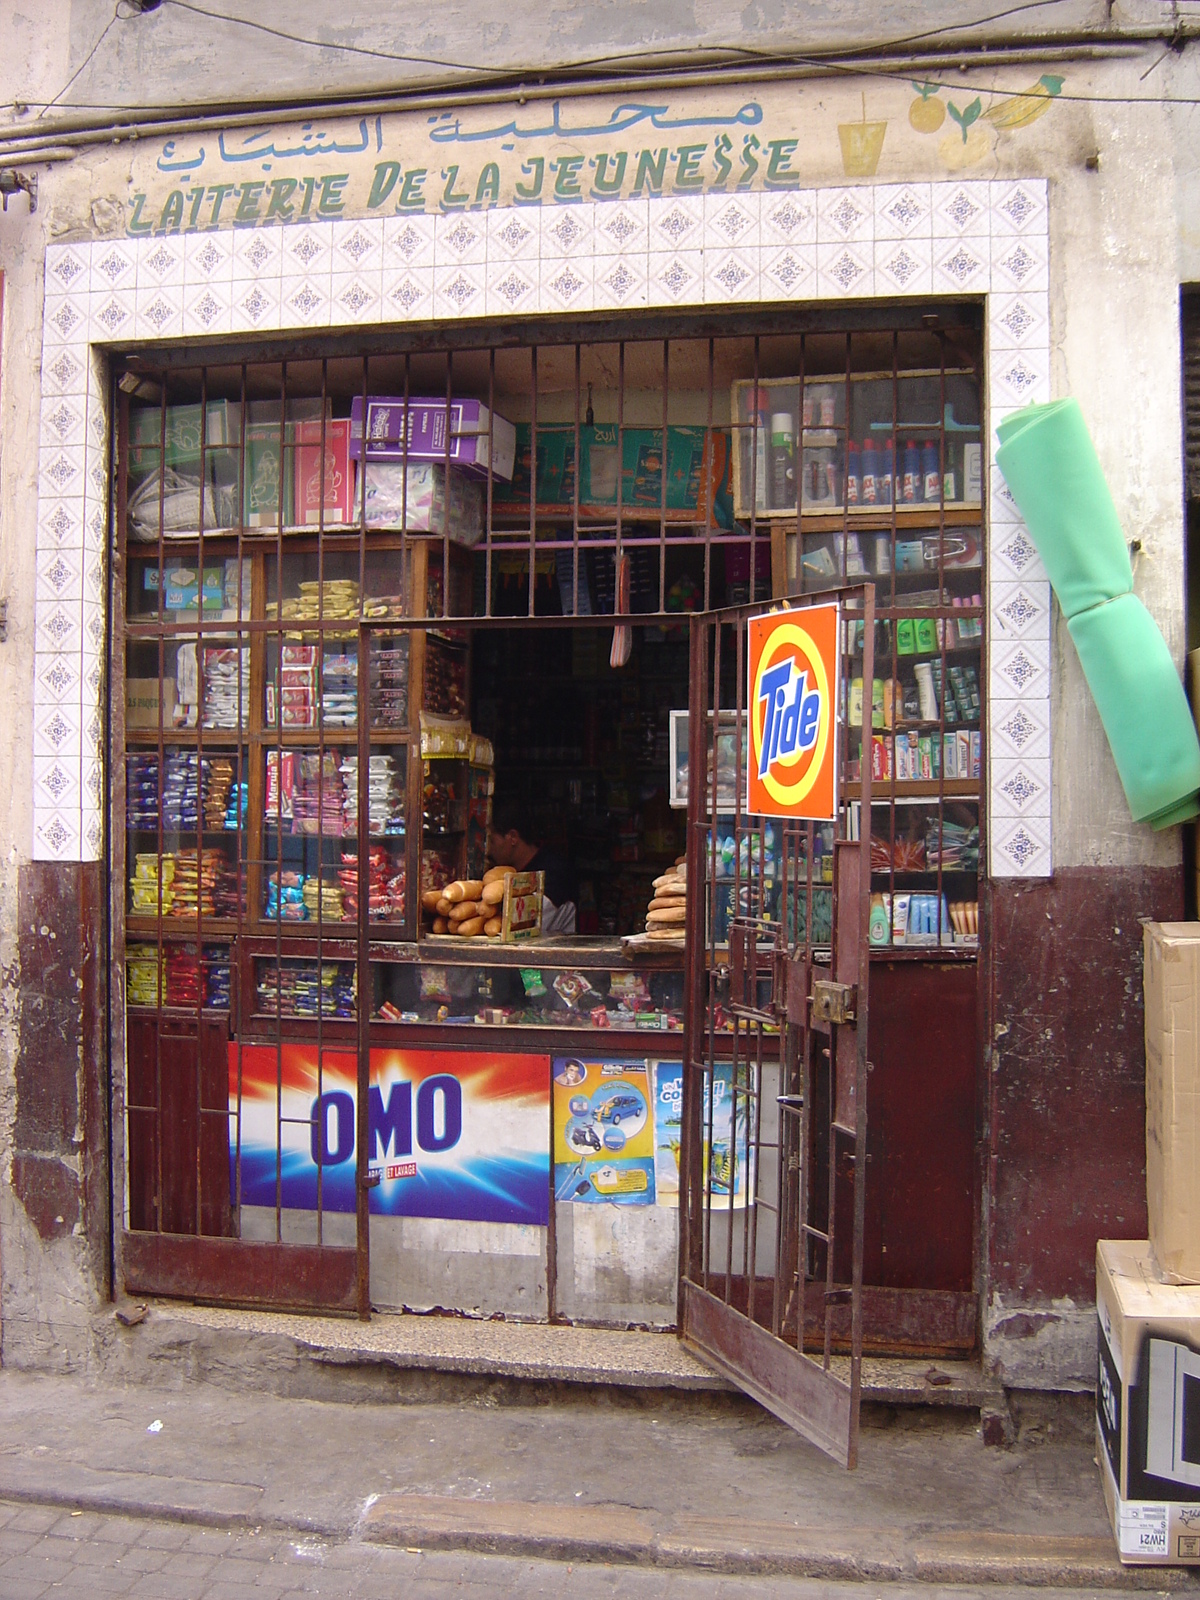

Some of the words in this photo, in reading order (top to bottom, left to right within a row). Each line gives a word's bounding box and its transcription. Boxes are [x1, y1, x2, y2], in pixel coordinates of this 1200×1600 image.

[127, 173, 350, 238] LAITERIE
[366, 161, 428, 215] DE
[440, 162, 500, 212] LA
[513, 134, 801, 207] JEUNESSE
[137, 698, 166, 709] PAQUES
[758, 657, 820, 780] Tide
[268, 766, 278, 803] Maruja
[310, 1072, 462, 1167] OMO
[394, 1164, 416, 1177] LAVAGE
[1140, 1534, 1166, 1546] HW21
